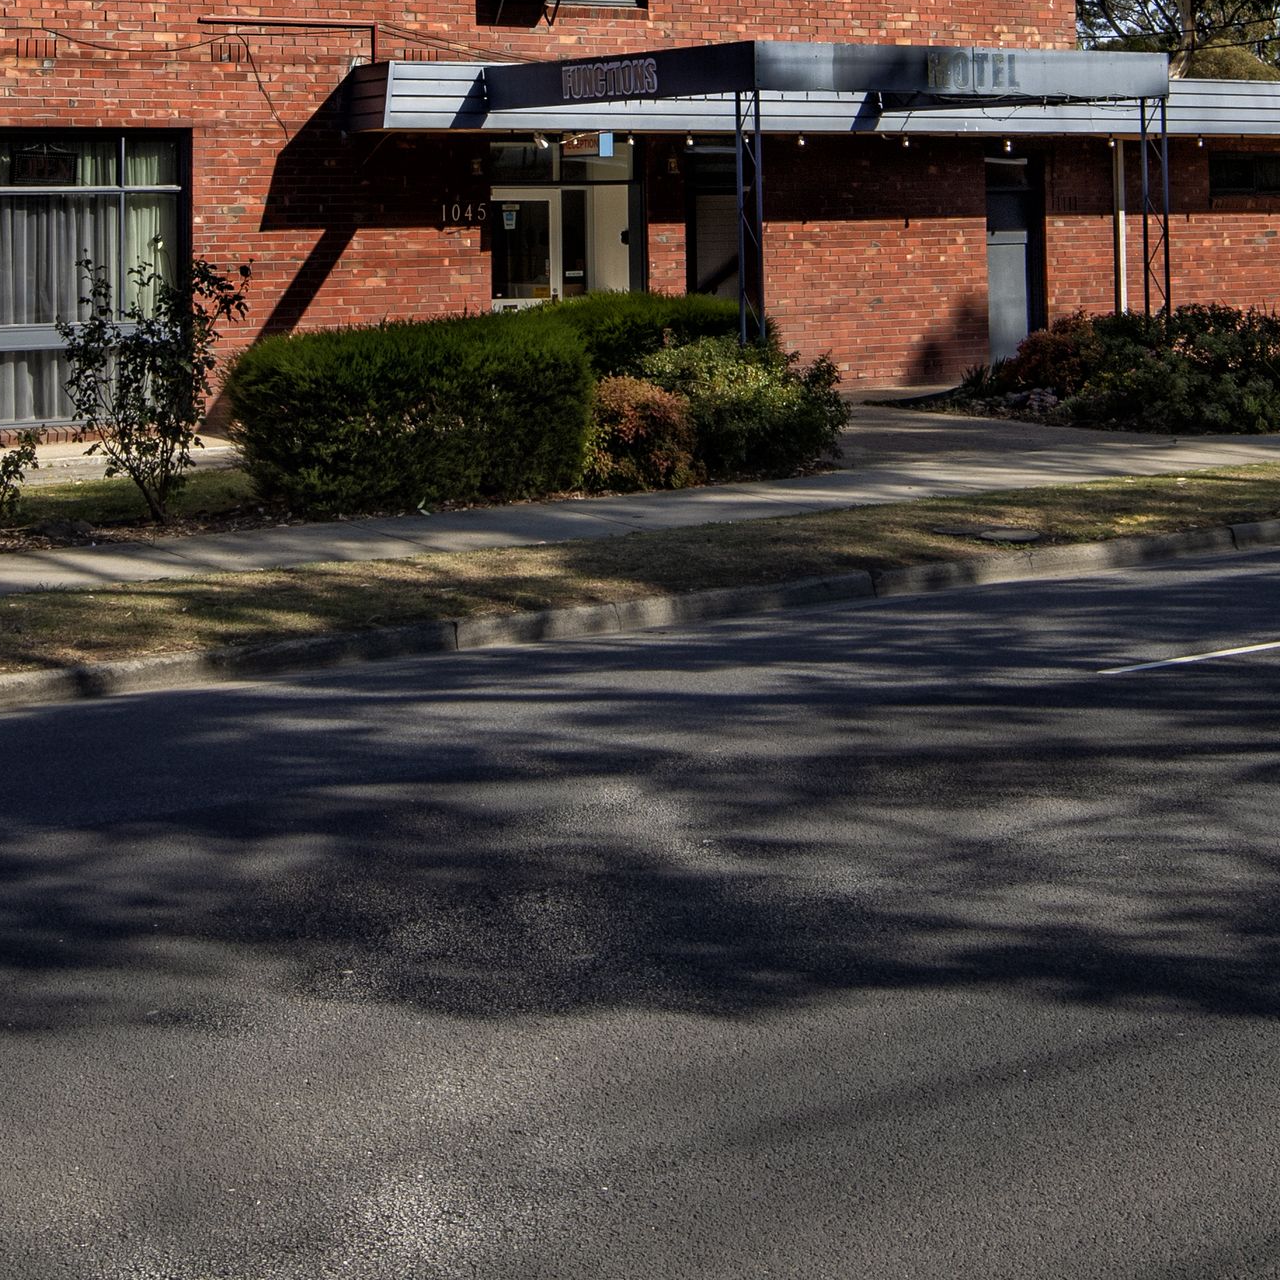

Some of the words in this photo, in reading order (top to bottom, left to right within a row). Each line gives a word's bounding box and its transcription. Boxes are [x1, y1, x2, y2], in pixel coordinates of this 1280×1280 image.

[561, 57, 658, 99] FUNCTIONS
[927, 51, 1020, 89] MOTEL
[442, 202, 487, 222] 1045
